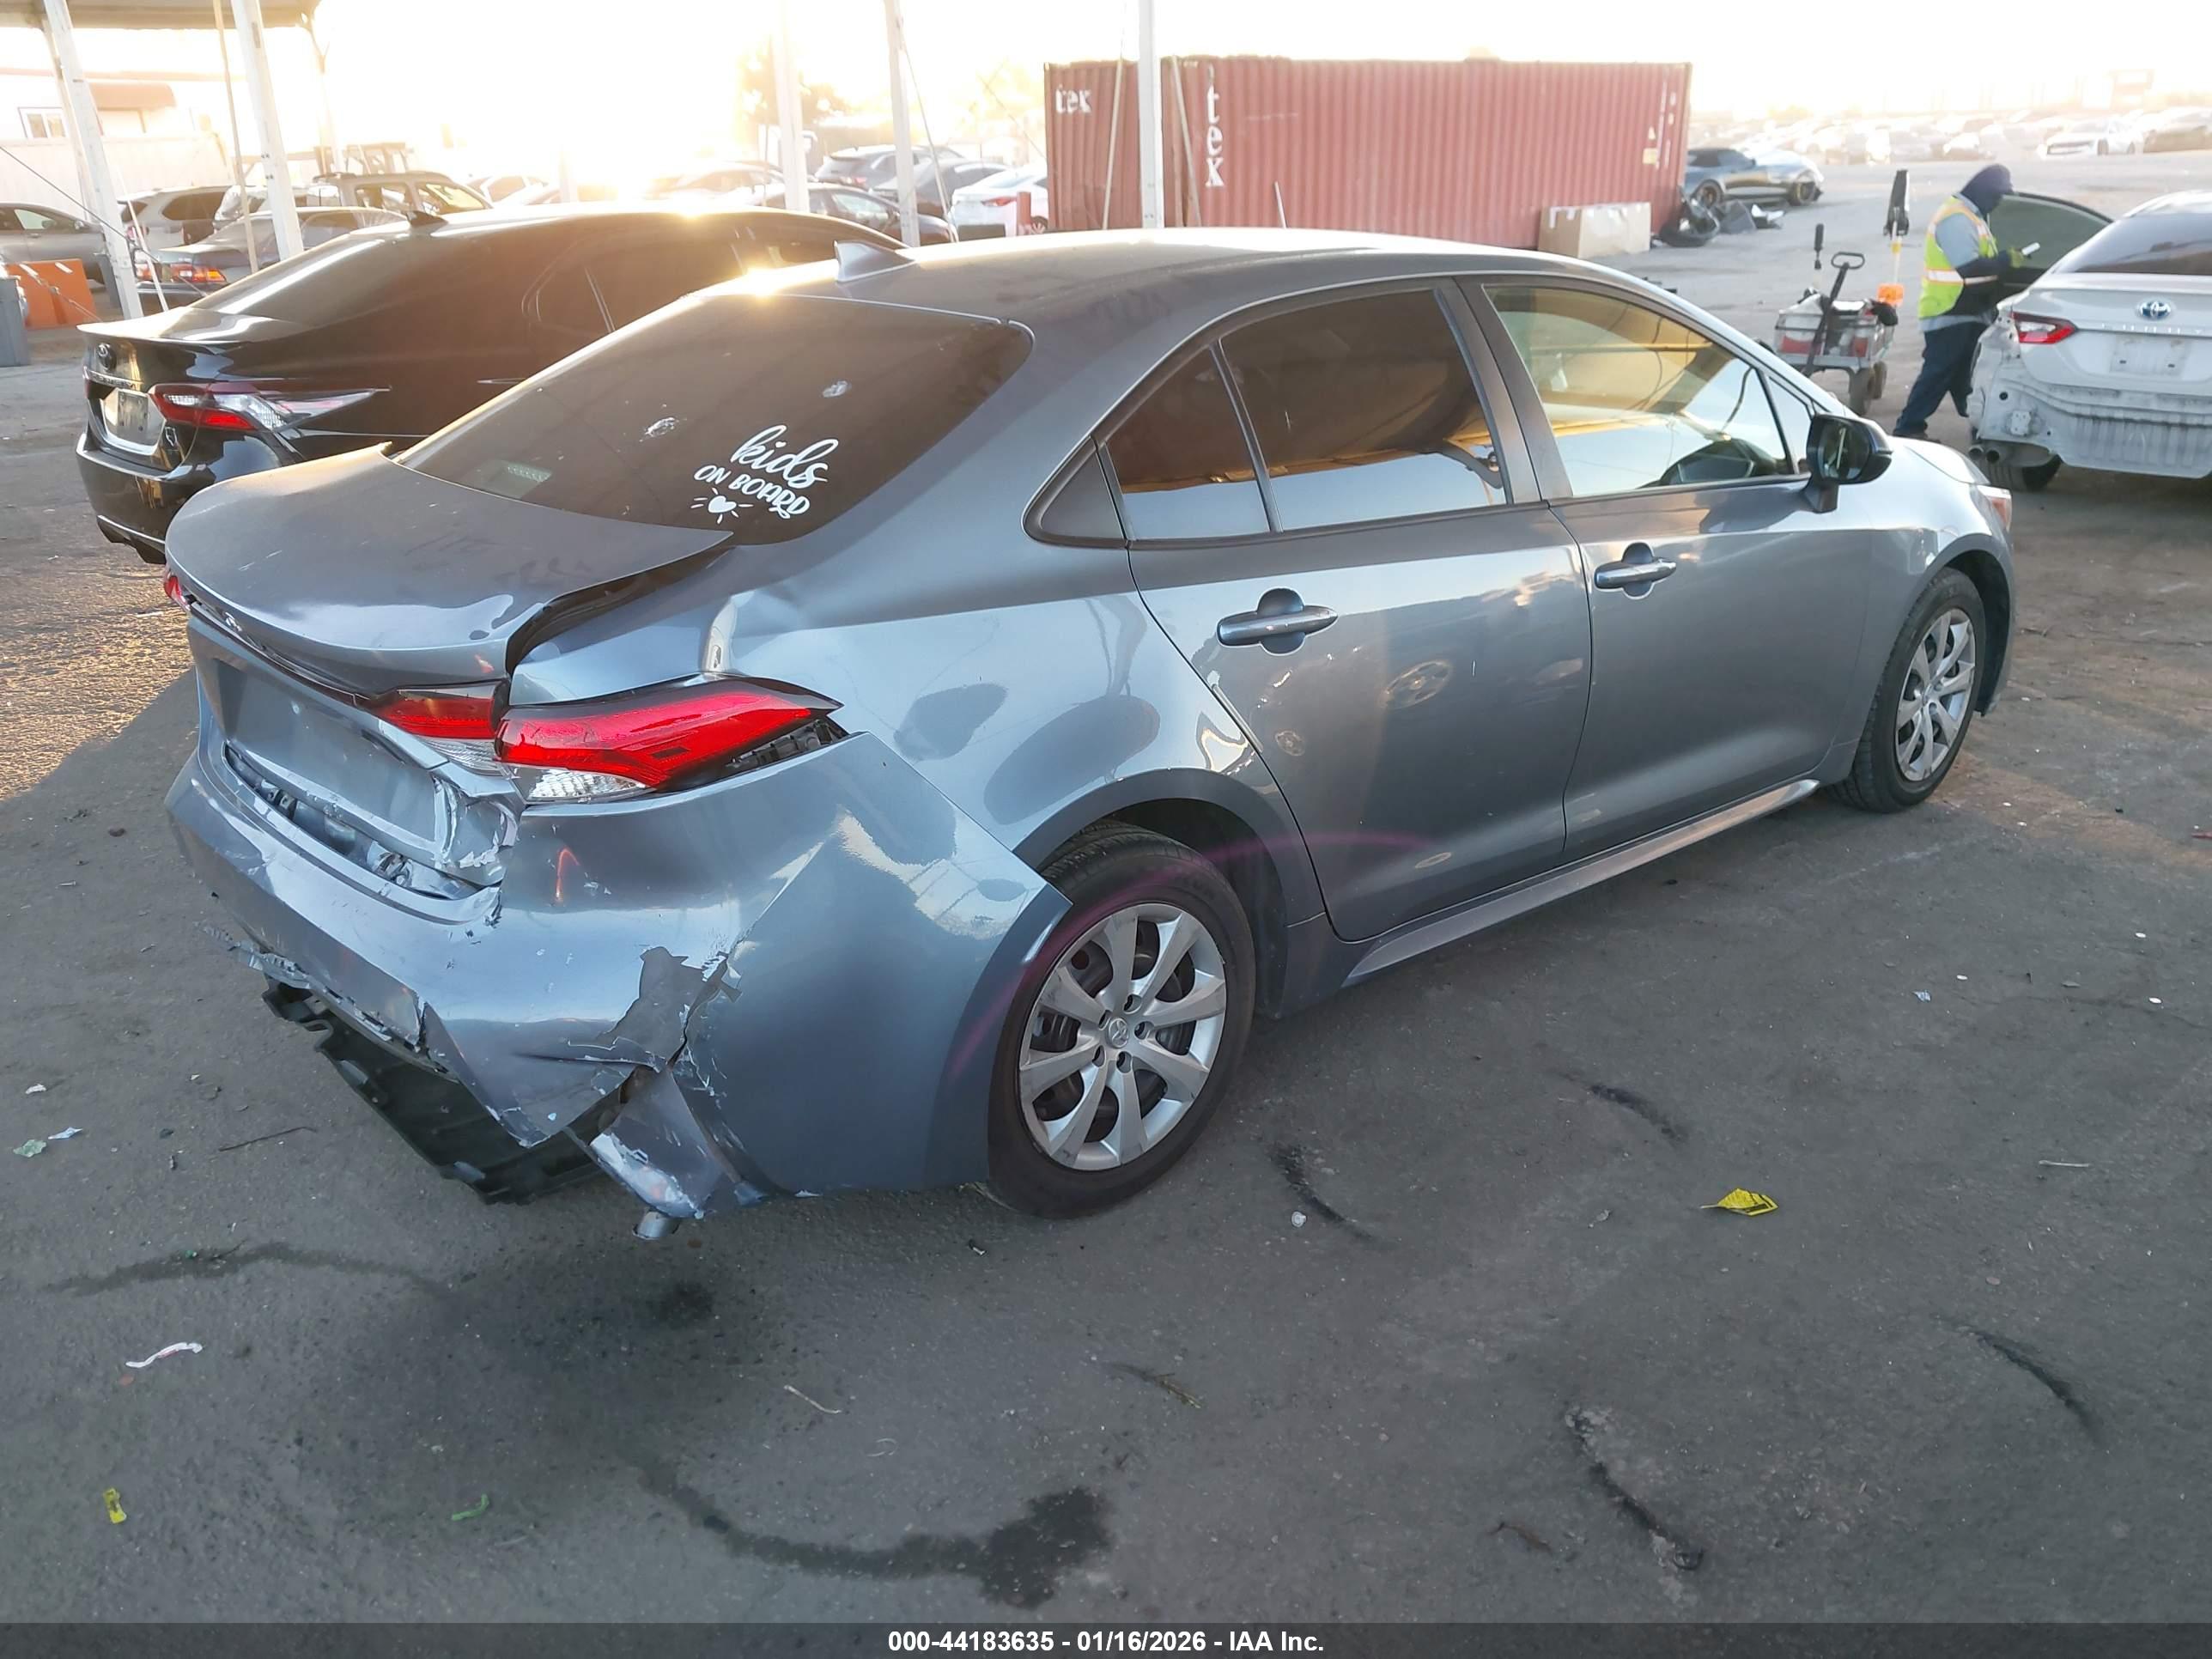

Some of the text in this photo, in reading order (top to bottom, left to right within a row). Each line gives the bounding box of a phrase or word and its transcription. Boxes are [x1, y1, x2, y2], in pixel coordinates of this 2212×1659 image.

[730, 424, 839, 489] kids
[694, 465, 811, 520] ON BOARD
